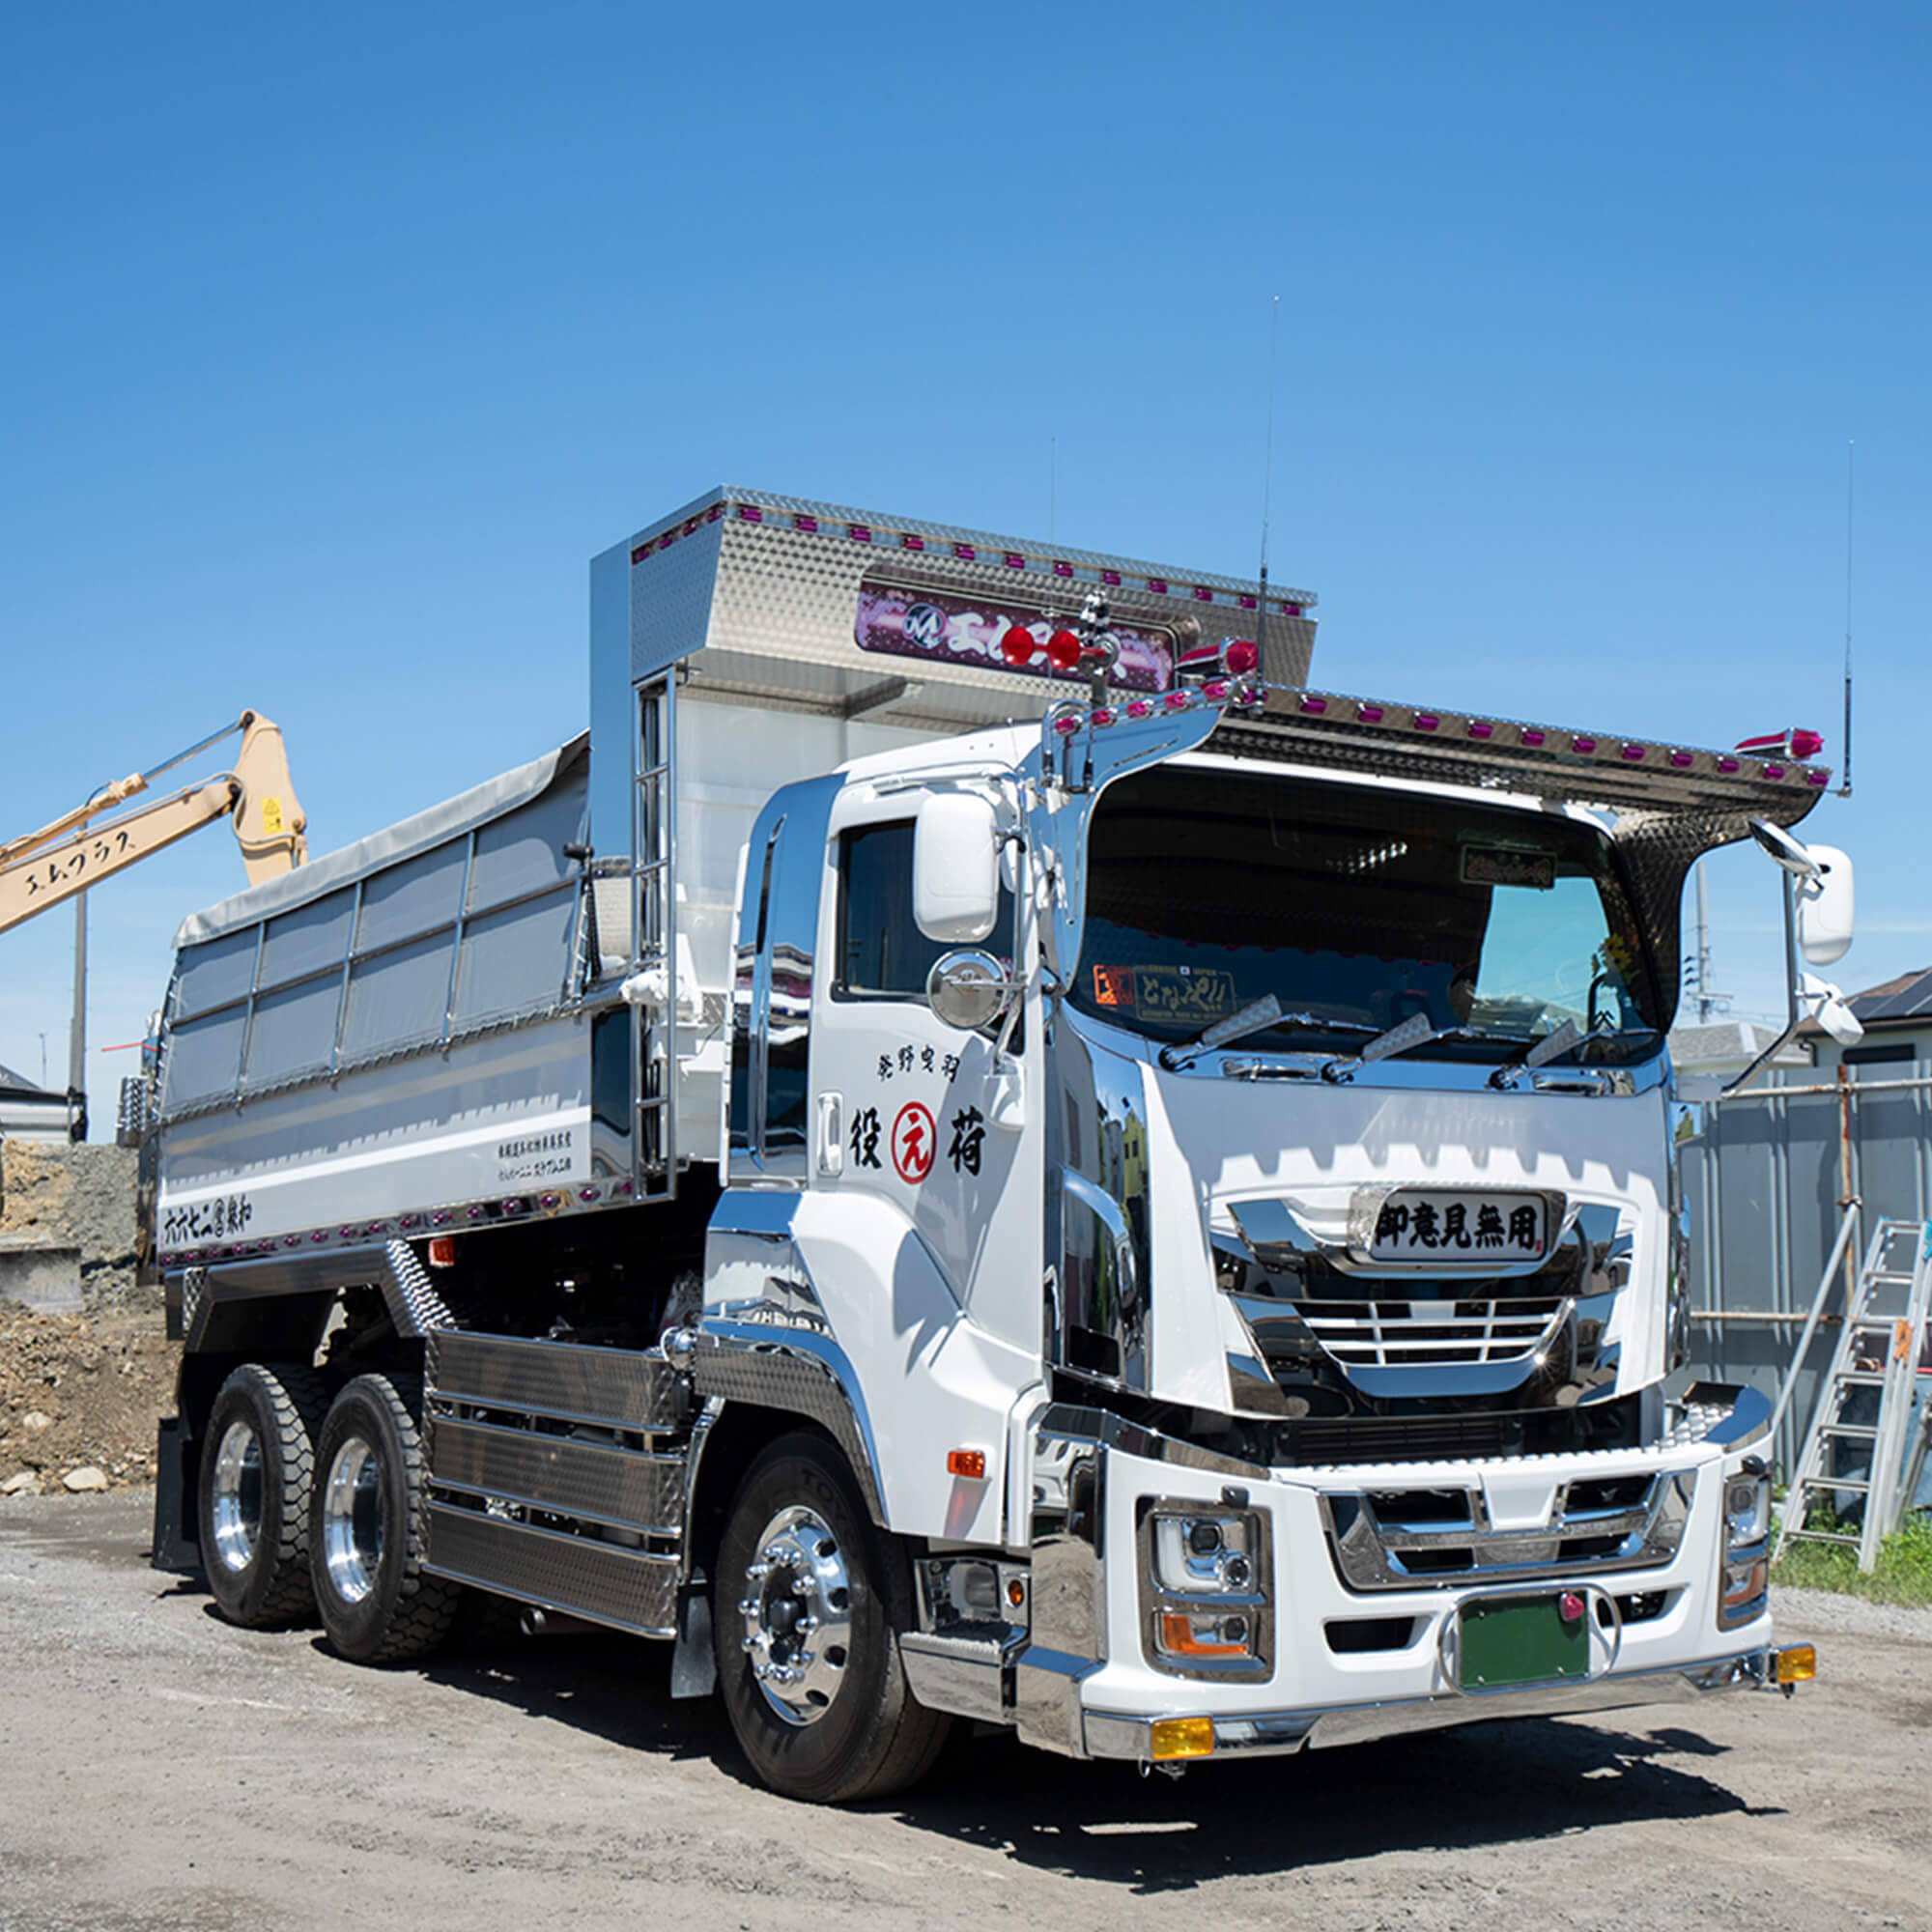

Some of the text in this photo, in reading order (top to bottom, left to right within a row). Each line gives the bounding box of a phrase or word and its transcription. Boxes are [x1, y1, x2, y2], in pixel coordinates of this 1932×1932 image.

[1375, 1201, 1538, 1250] 御意見無用
